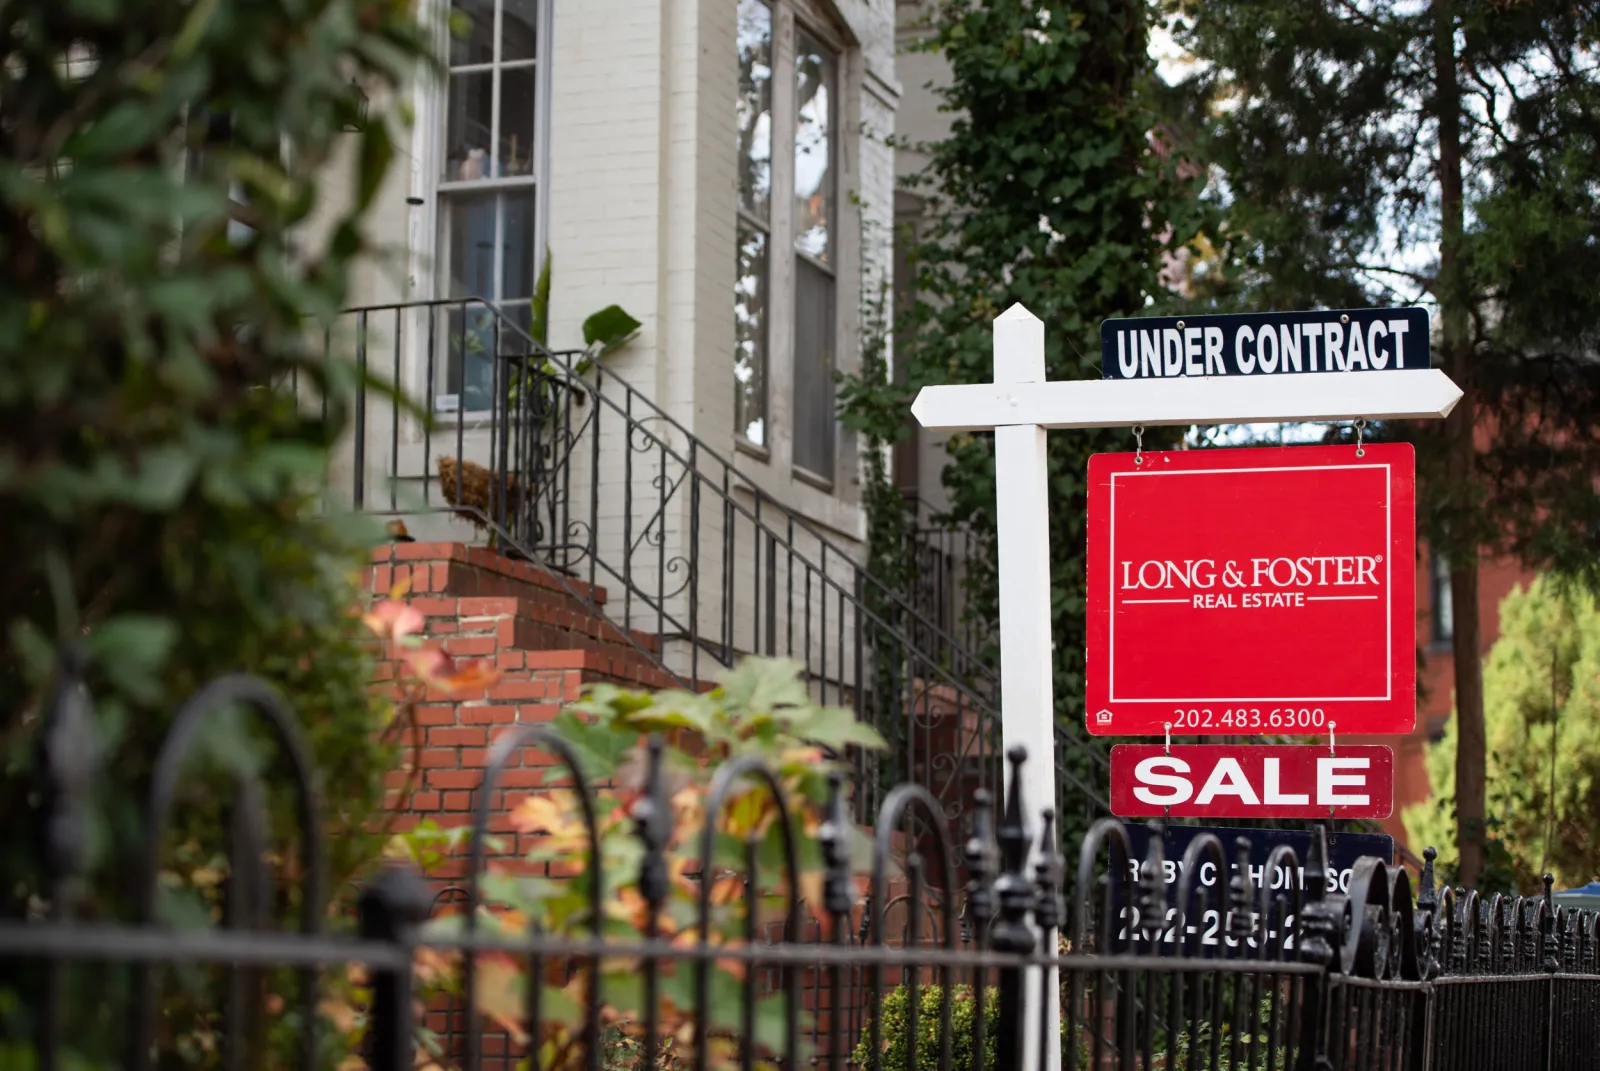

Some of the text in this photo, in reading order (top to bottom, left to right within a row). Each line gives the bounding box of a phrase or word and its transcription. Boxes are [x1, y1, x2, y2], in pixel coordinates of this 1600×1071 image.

[1117, 319, 1410, 379] UNDER CONTRACT
[1121, 559, 1216, 590] LONG
[1222, 560, 1247, 588] &
[1193, 592, 1305, 609] REAL ESTATE
[1173, 708, 1326, 728] 202.483.6300
[1133, 756, 1371, 806] SALE
[1123, 858, 1195, 884] RB
[1199, 861, 1218, 887] C
